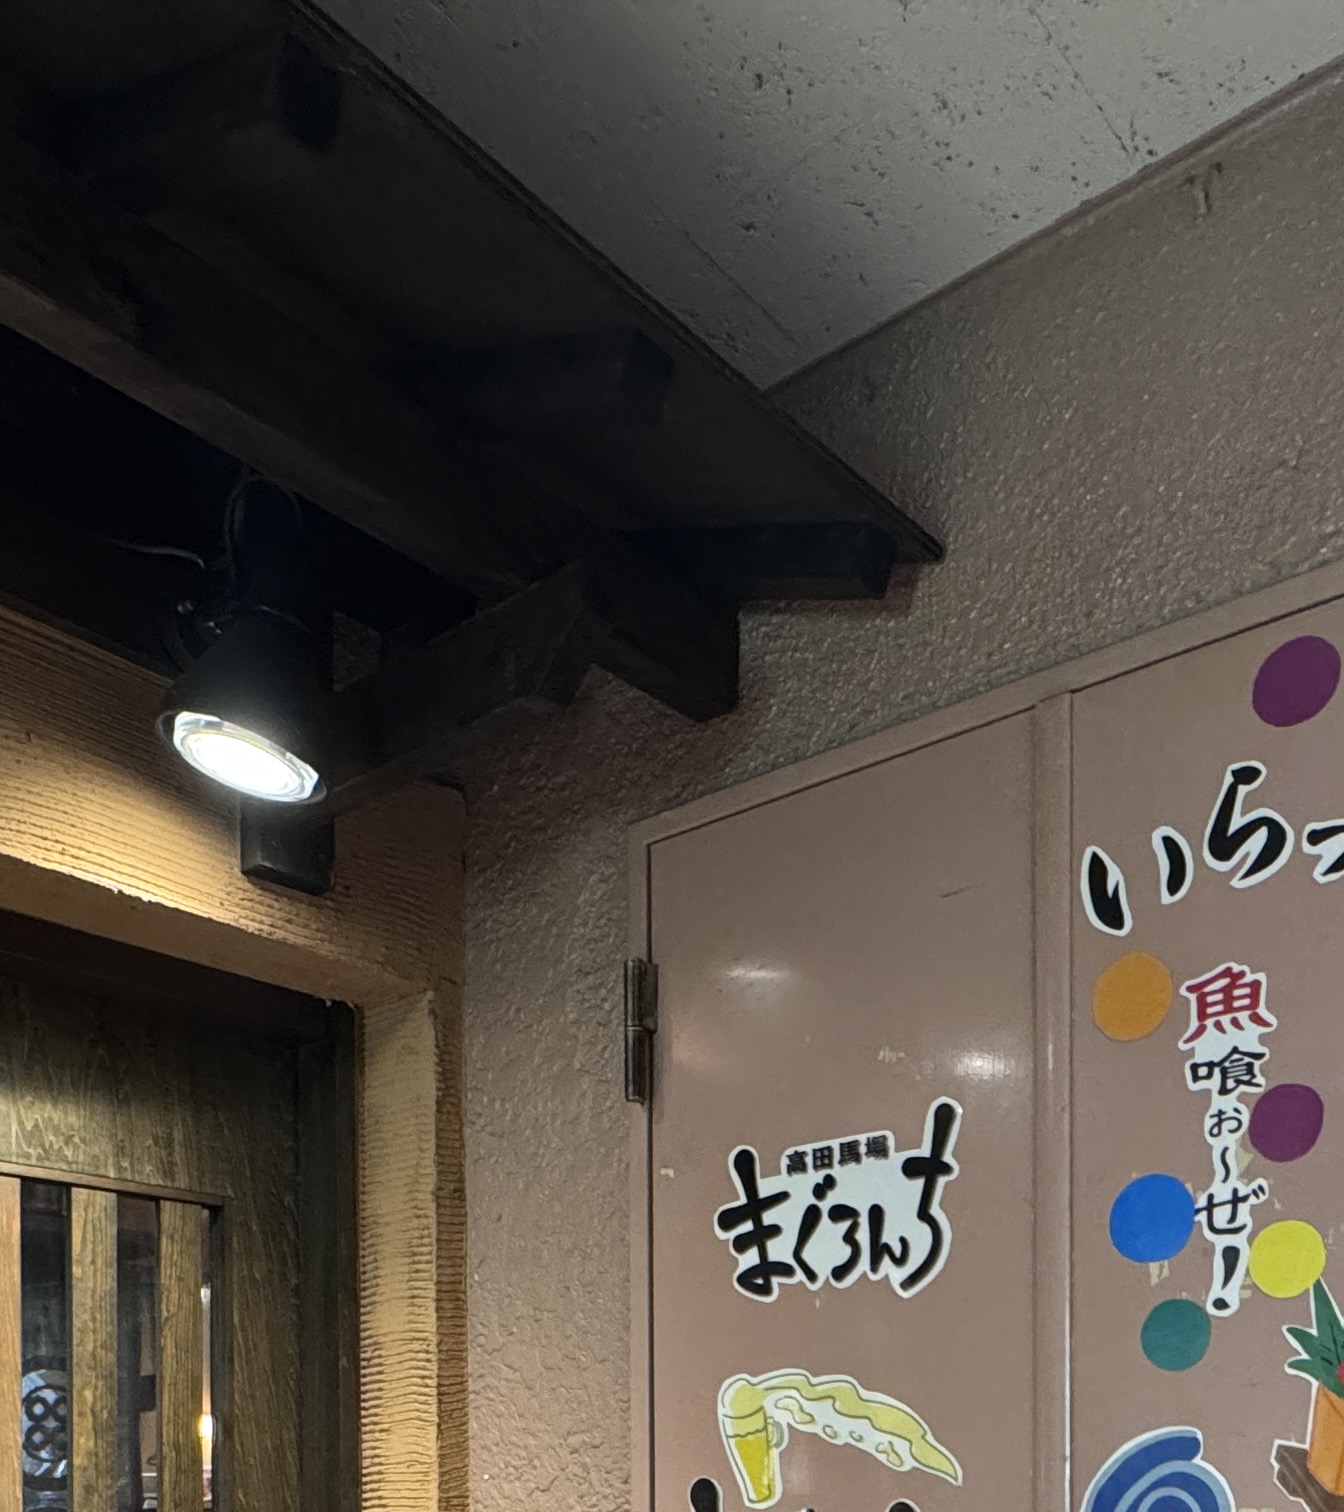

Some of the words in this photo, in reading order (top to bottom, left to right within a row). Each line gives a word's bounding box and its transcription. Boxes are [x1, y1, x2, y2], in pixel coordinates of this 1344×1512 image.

[717, 1102, 957, 1296] まぐろんち
[786, 1134, 891, 1177] 高田馬場
